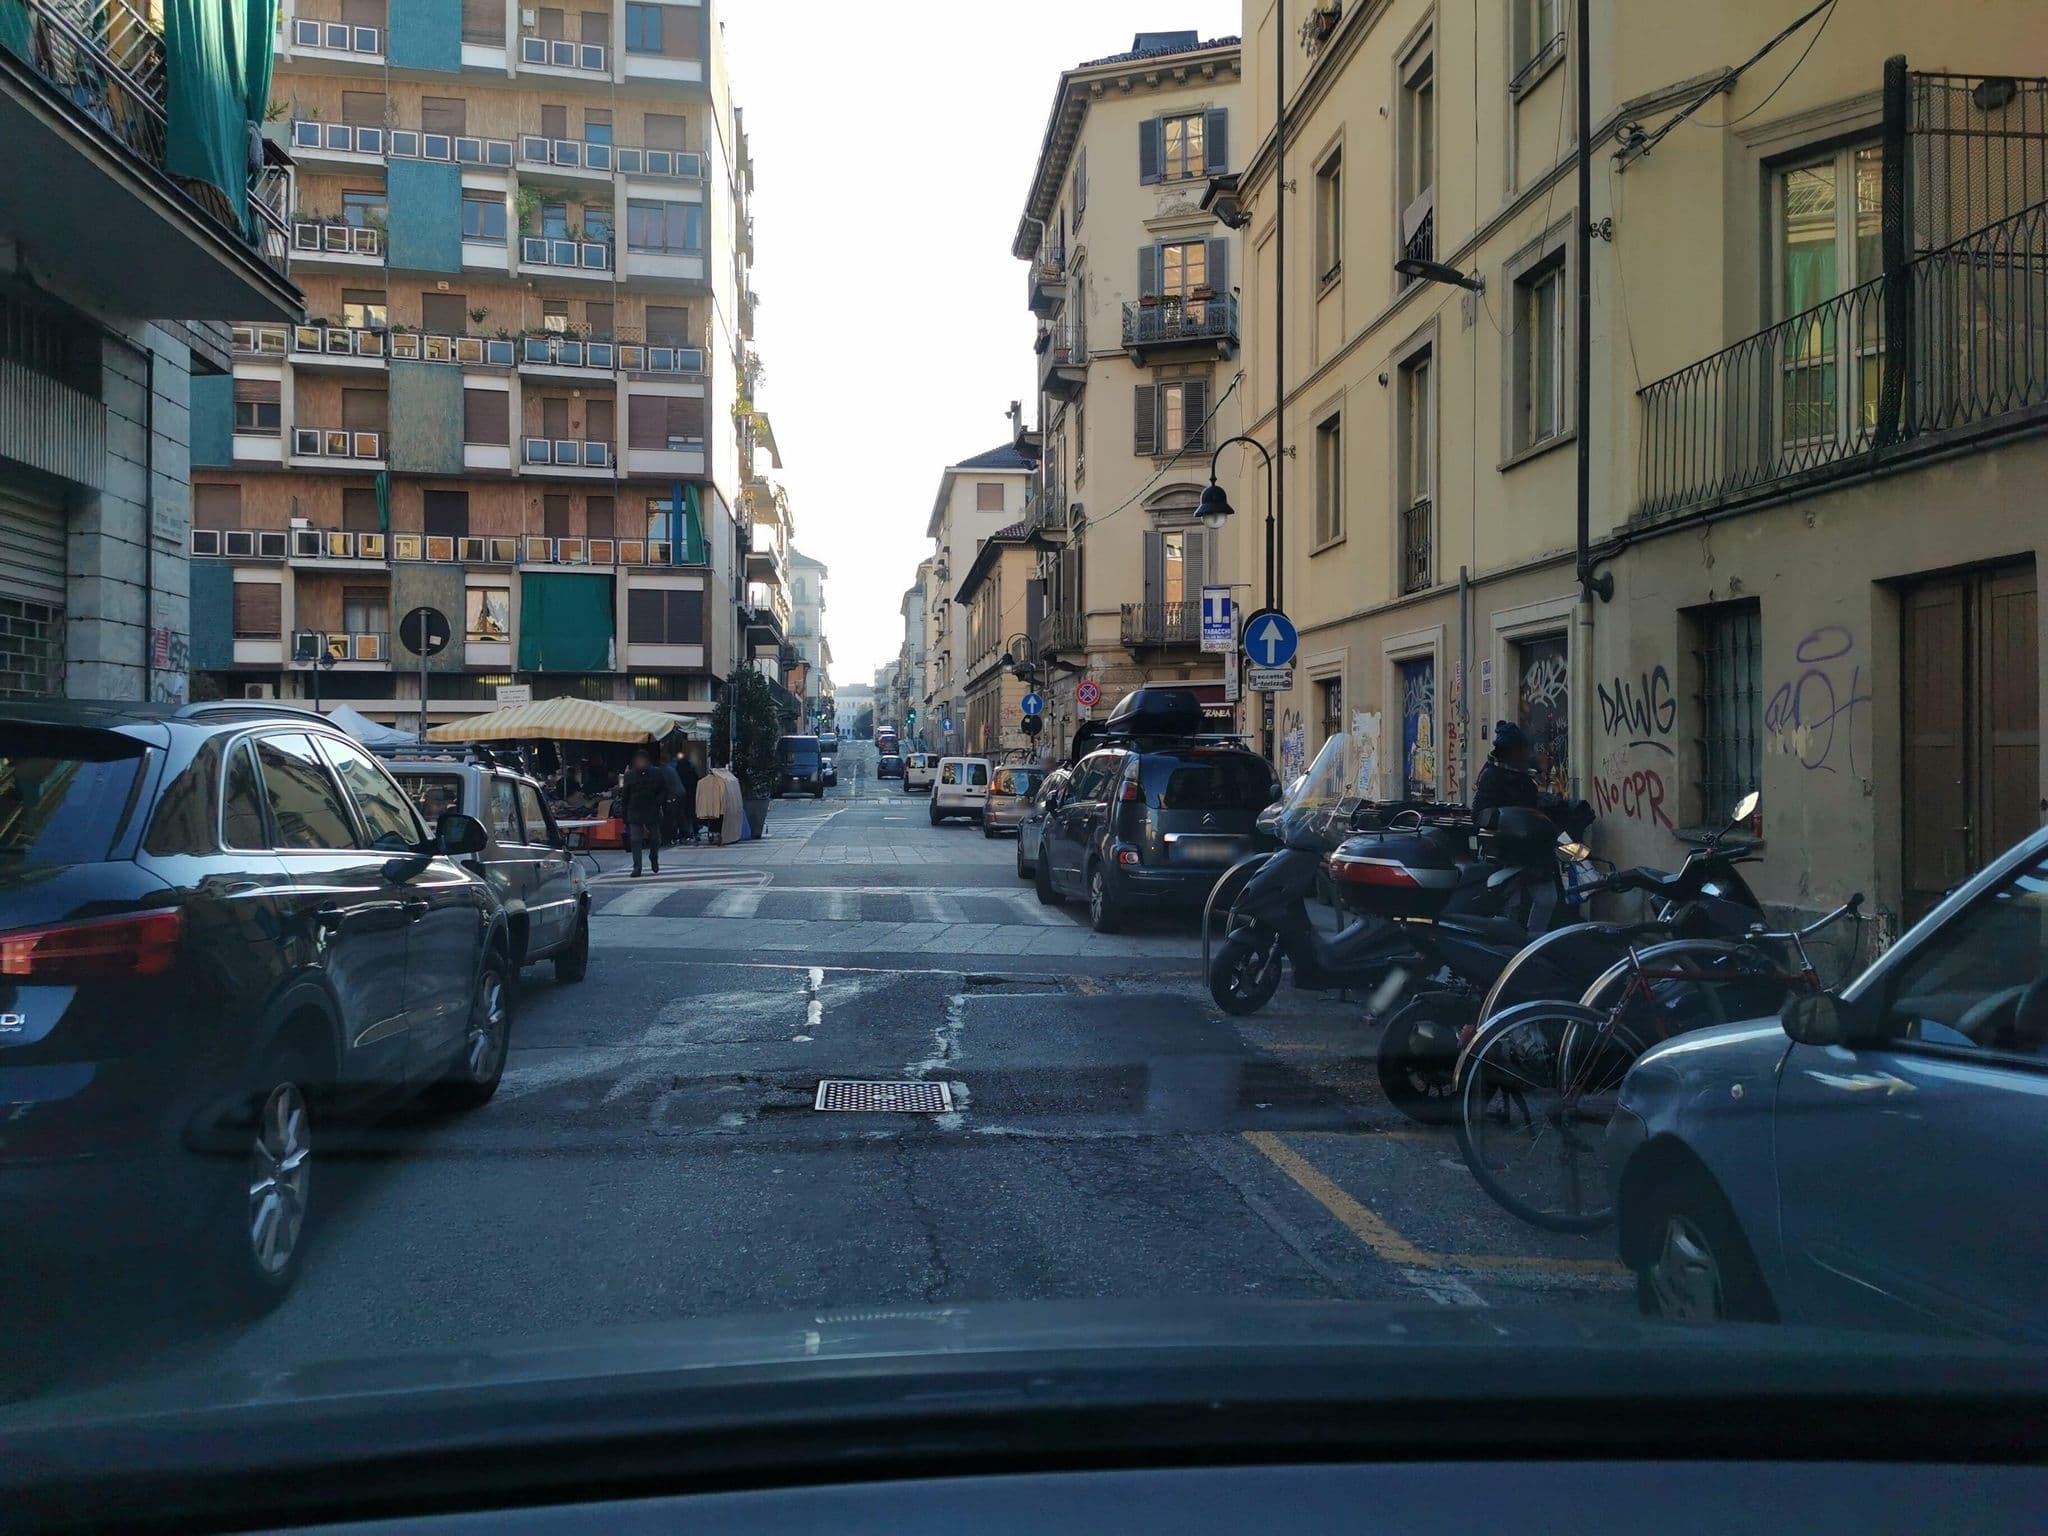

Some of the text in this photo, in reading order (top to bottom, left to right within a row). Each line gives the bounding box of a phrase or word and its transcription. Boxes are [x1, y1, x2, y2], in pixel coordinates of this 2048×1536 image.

[1597, 664, 1676, 737] DAWG
[1622, 768, 1675, 832] CPR
[0, 1013, 26, 1026] DI
